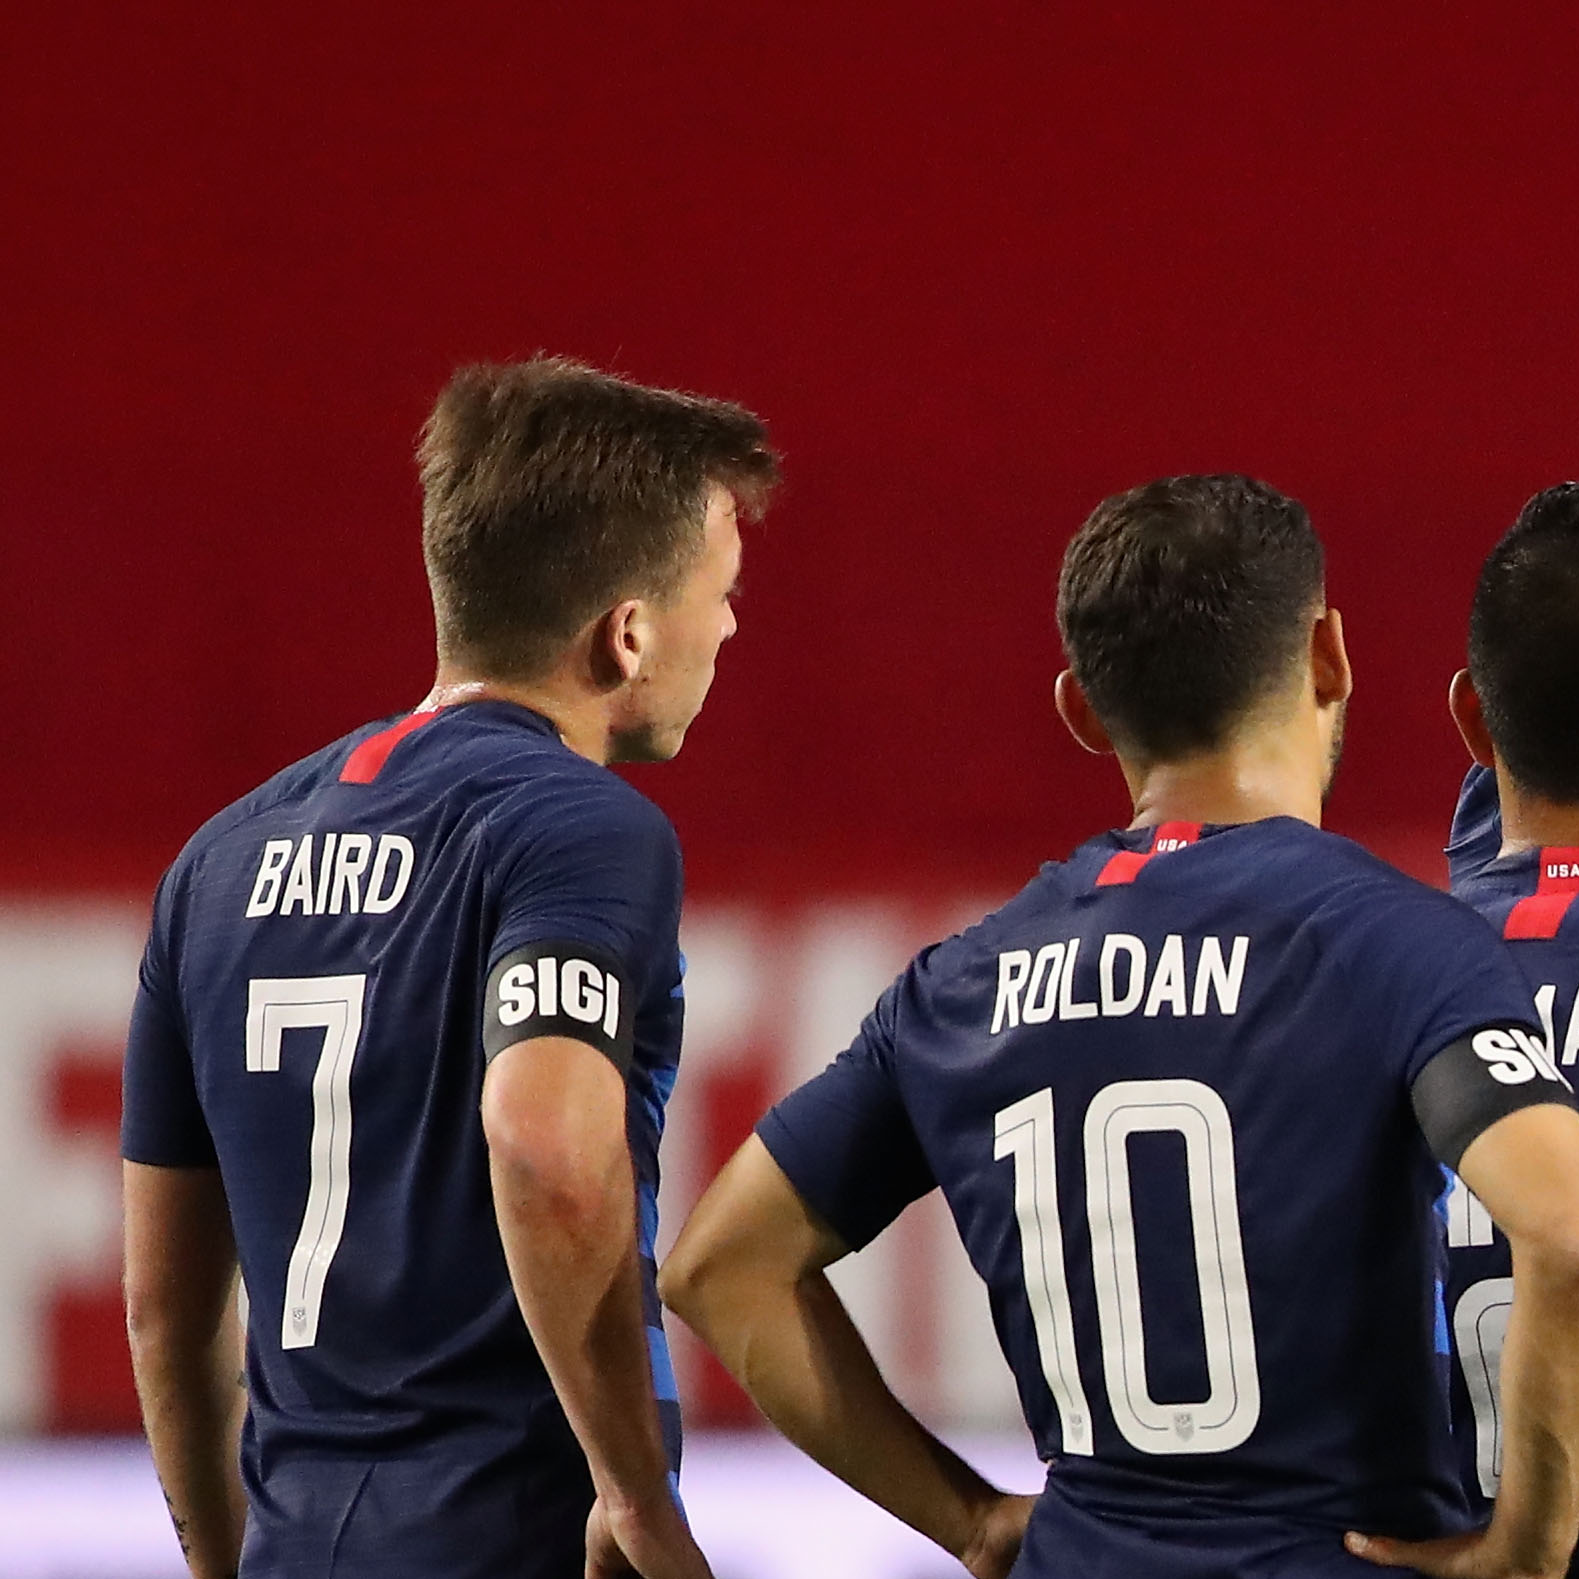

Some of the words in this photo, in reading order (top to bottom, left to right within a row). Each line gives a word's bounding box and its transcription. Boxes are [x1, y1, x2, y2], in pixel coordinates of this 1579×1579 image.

[245, 833, 414, 918] BAIRD
[497, 957, 620, 1040] SIGI
[990, 933, 1250, 1035] ROLDAN
[246, 974, 367, 1351] 7
[990, 1079, 1261, 1457] 10
